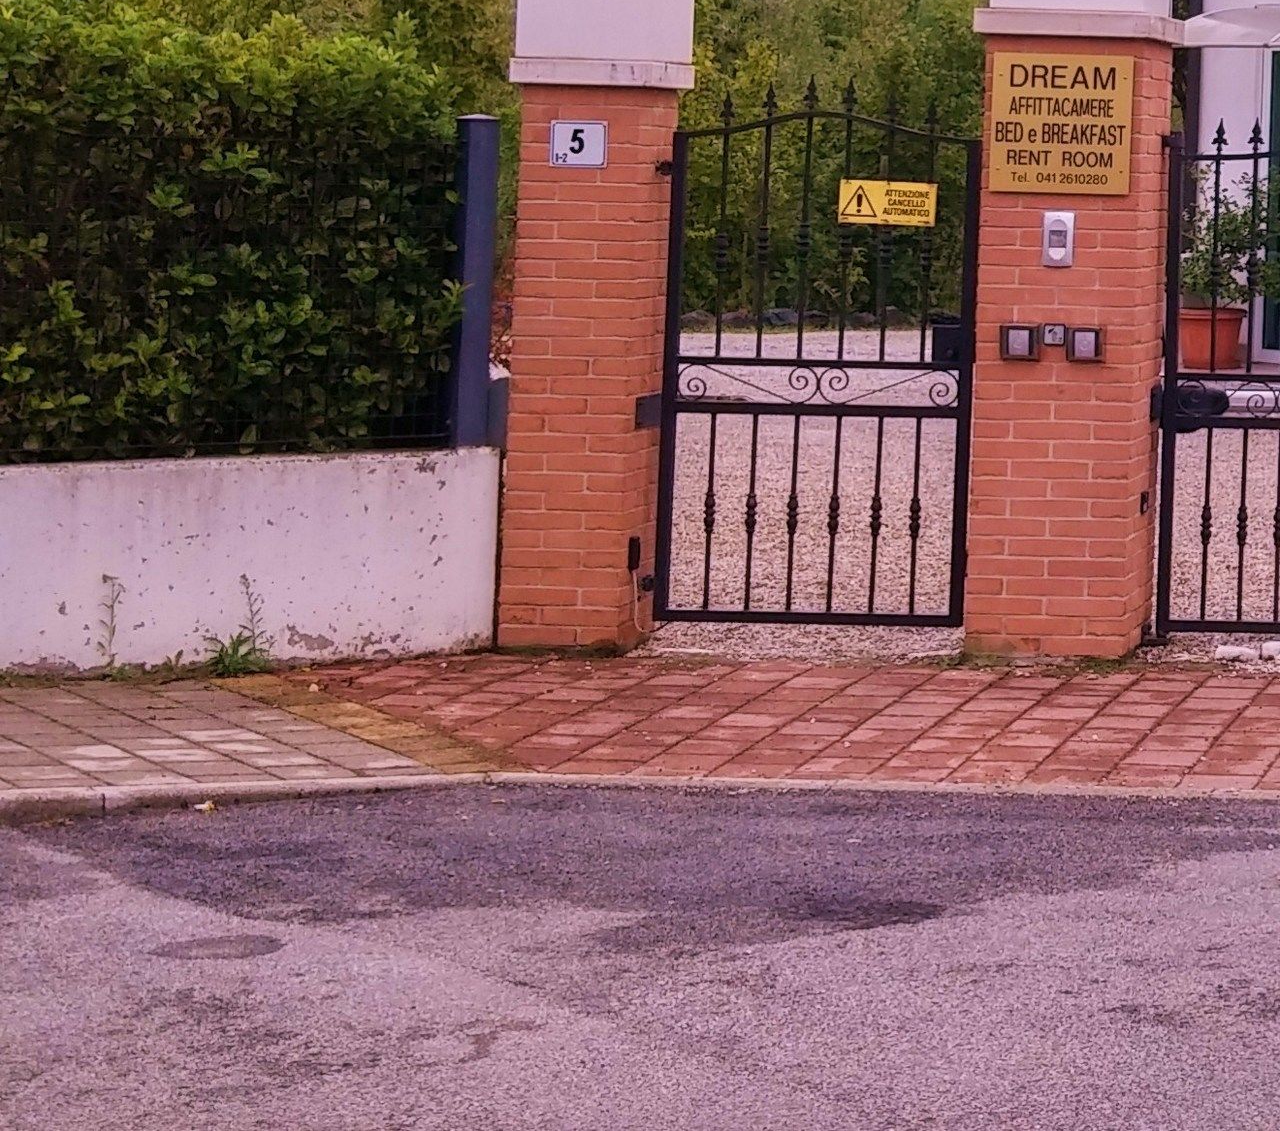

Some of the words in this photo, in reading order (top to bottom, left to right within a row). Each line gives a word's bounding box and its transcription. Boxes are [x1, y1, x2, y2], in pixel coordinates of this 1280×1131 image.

[1009, 64, 1117, 90] DREAM
[1009, 96, 1114, 118] AFFITTACAMERE
[569, 128, 585, 154] 5
[995, 121, 1024, 143] BED
[1028, 128, 1037, 144] e
[1041, 123, 1126, 146] BREAKFAST
[1006, 149, 1052, 166] RENT
[1062, 151, 1113, 168] ROOM
[1011, 171, 1030, 183] Tel.
[885, 189, 930, 199] ATTENZIONE
[888, 198, 926, 208] CANCELLO
[882, 207, 930, 217] AUTOMATICO
